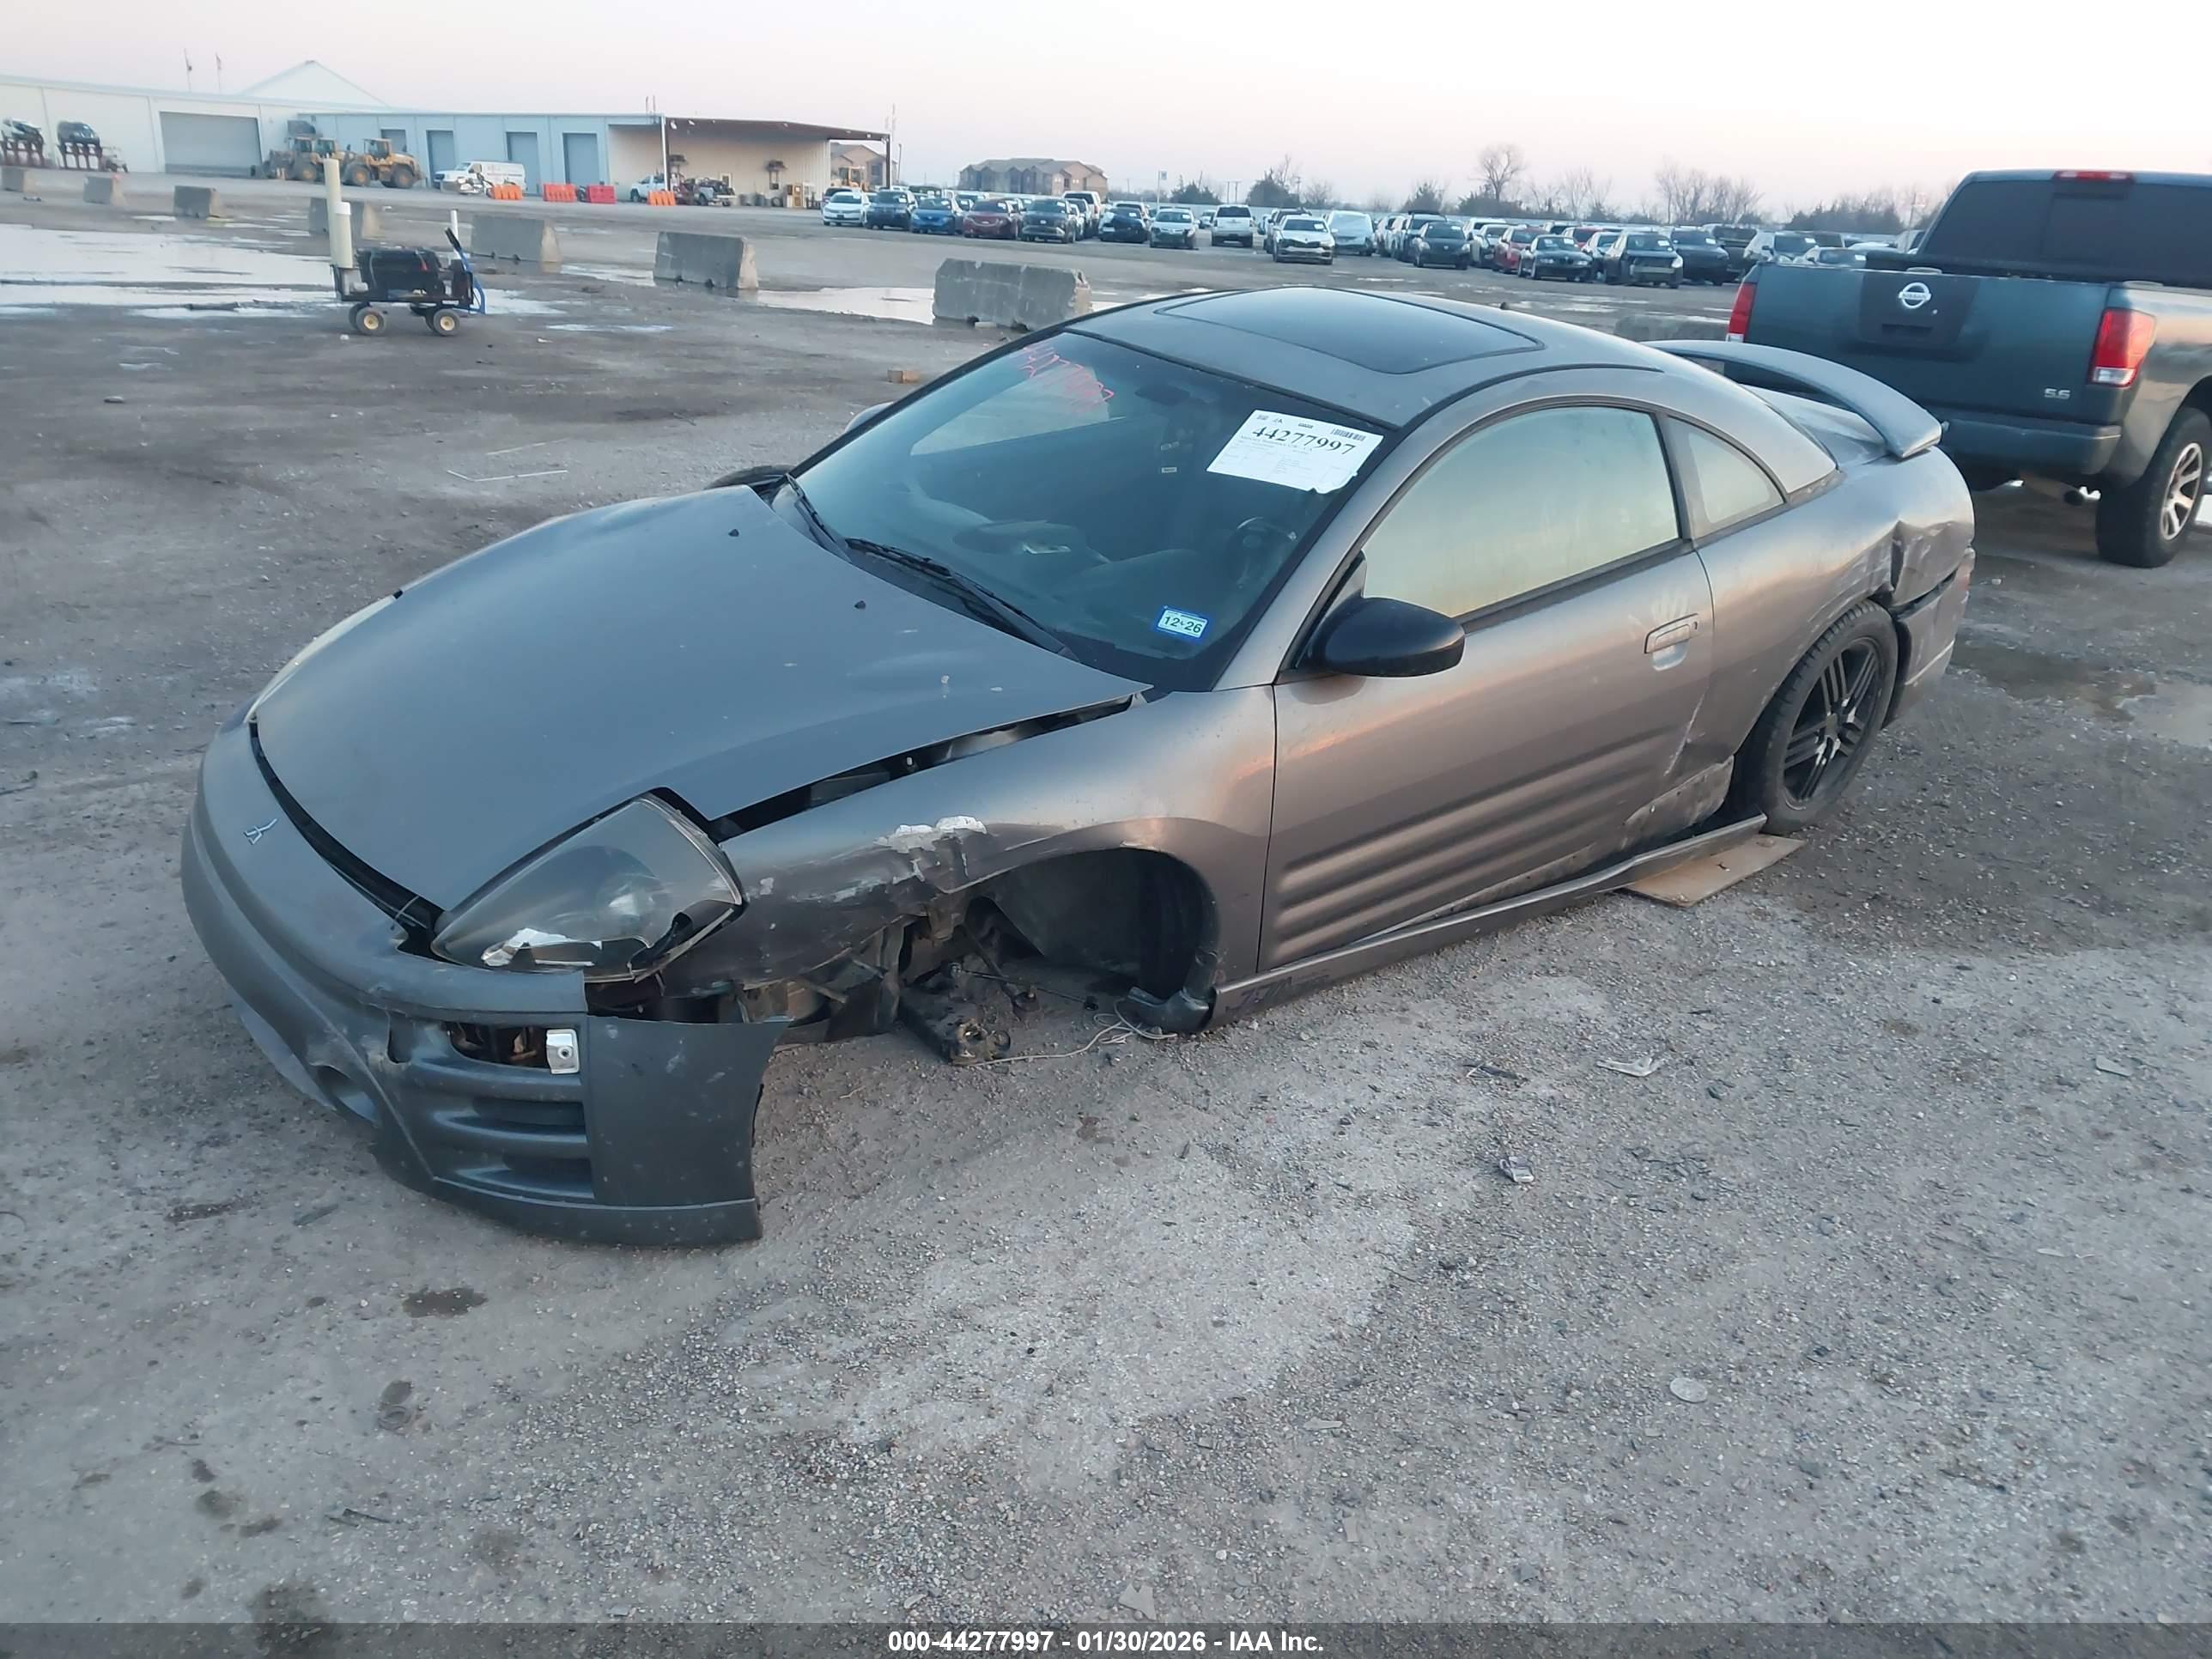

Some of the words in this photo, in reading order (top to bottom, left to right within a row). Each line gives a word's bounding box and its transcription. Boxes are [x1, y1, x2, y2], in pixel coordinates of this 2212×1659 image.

[1252, 426, 1357, 454] 44277997
[1164, 616, 1181, 628] 12
[1184, 621, 1203, 634] 26
